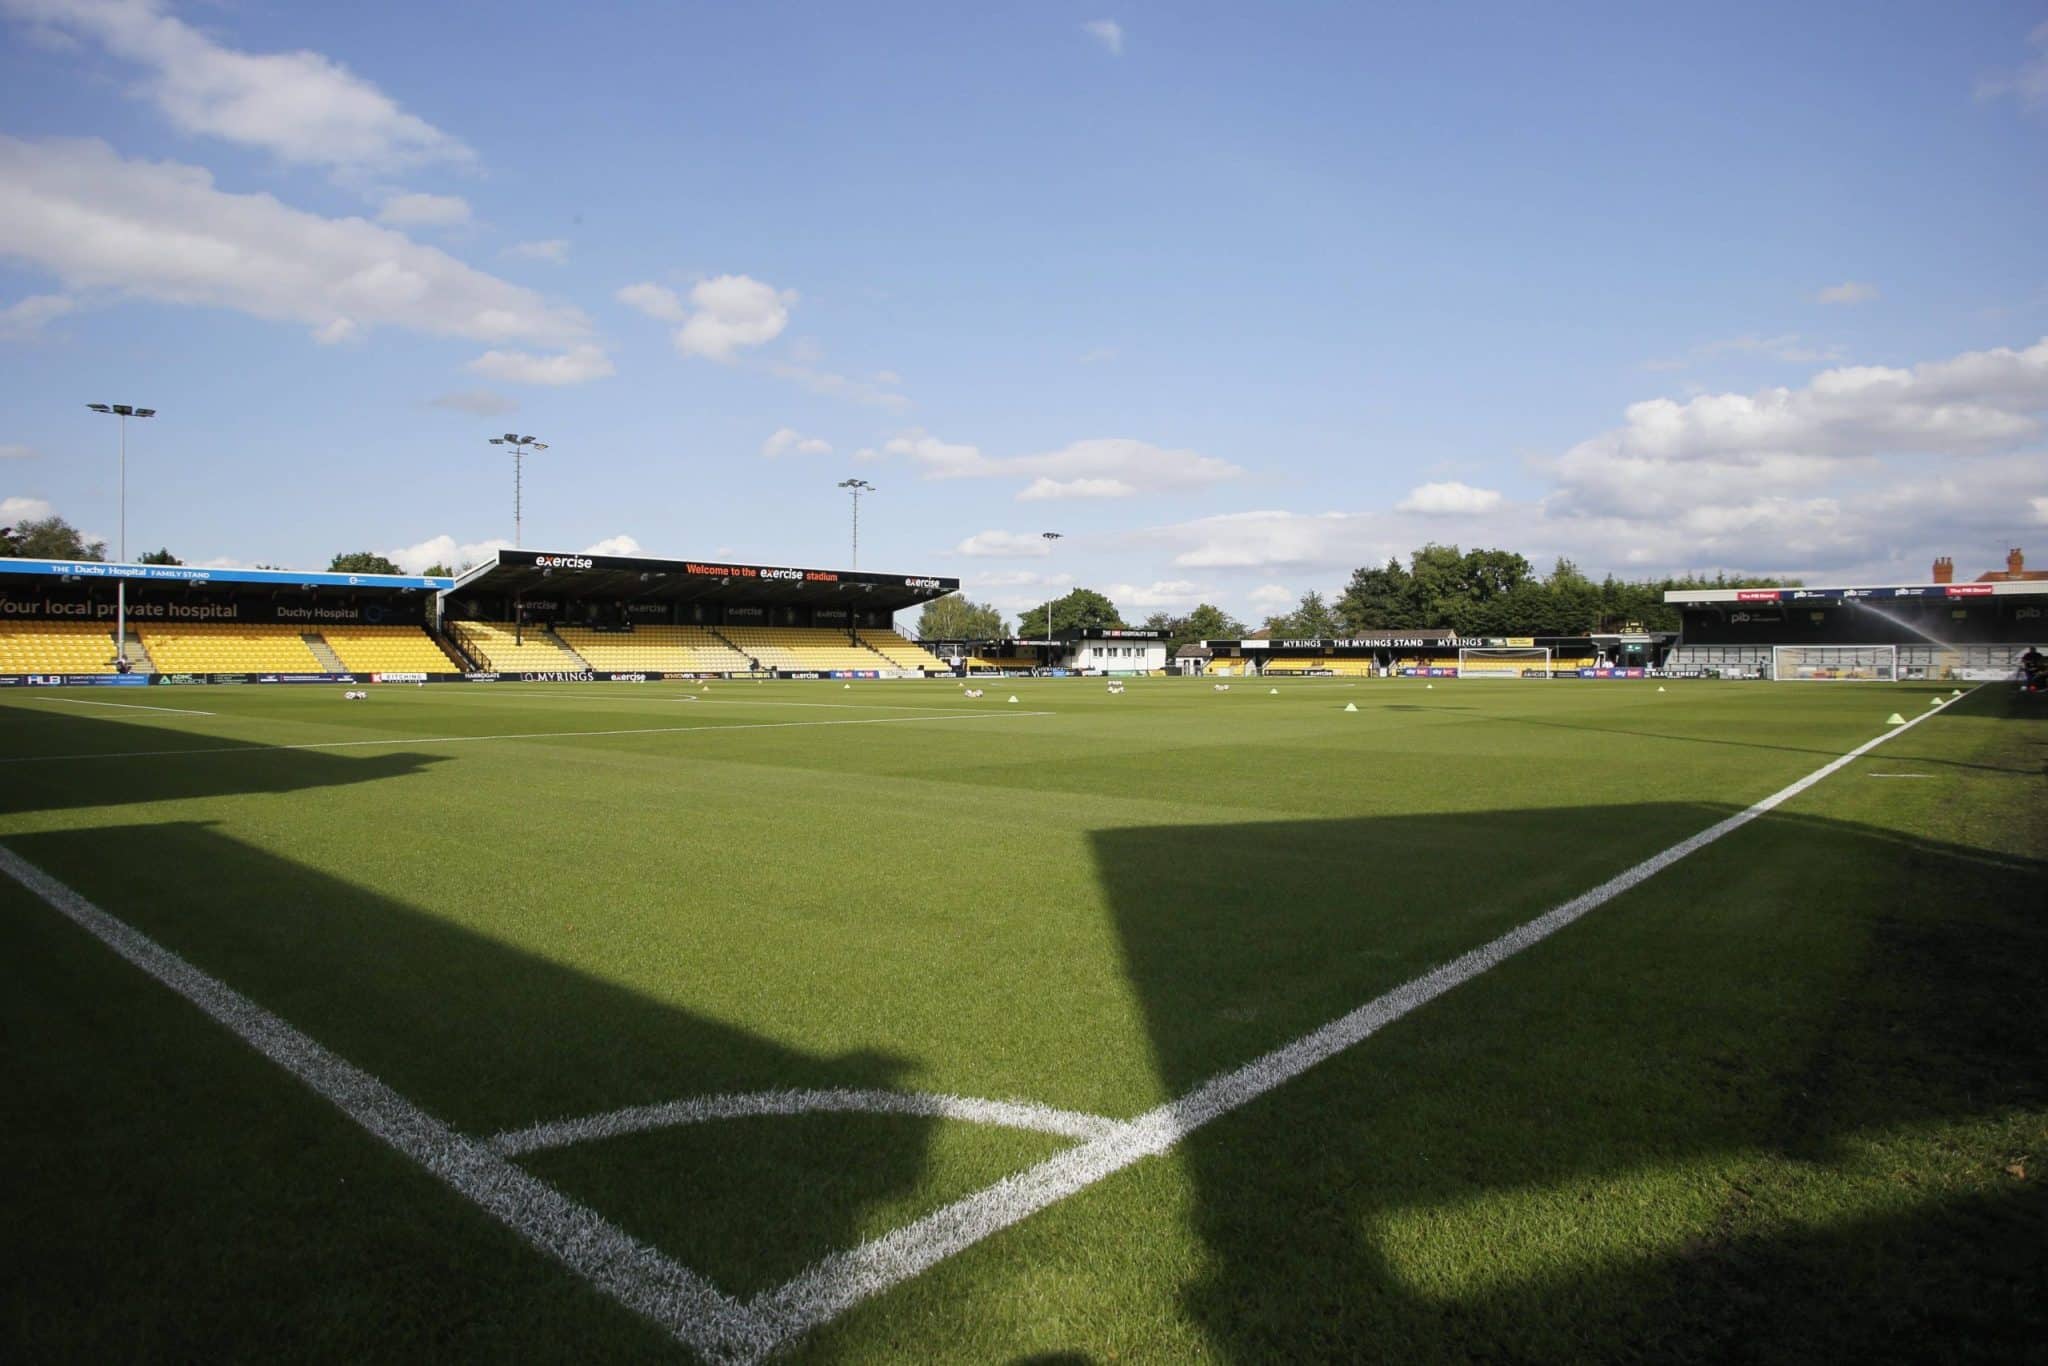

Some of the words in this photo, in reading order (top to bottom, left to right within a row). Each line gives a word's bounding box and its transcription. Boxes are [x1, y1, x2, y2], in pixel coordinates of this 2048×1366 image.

[536, 555, 593, 569] exercise
[74, 566, 105, 576] Duchy
[109, 567, 147, 577] Hospital
[151, 570, 181, 578] FAMILY
[687, 564, 729, 575] Welcome
[731, 568, 740, 576] to
[742, 568, 757, 579] the
[760, 568, 804, 580] exercise
[806, 573, 838, 582] stadium
[905, 577, 940, 588] exercise
[46, 599, 91, 615] local
[97, 602, 163, 618] prvate
[169, 602, 237, 620] hospital
[277, 607, 312, 619] Duchy
[315, 608, 358, 619] Hospital
[1731, 612, 1750, 624] pib
[1283, 640, 1321, 648] MYRINGS
[1333, 640, 1349, 648] THE
[1351, 639, 1392, 648] MYRINGS
[1394, 639, 1423, 647] STAND
[1438, 639, 1482, 647] MYRINGS
[537, 672, 594, 682] MYRINGS
[611, 672, 646, 681] exercise
[1583, 669, 1595, 678] sky
[1614, 669, 1626, 677] sky
[27, 675, 61, 685] HLB
